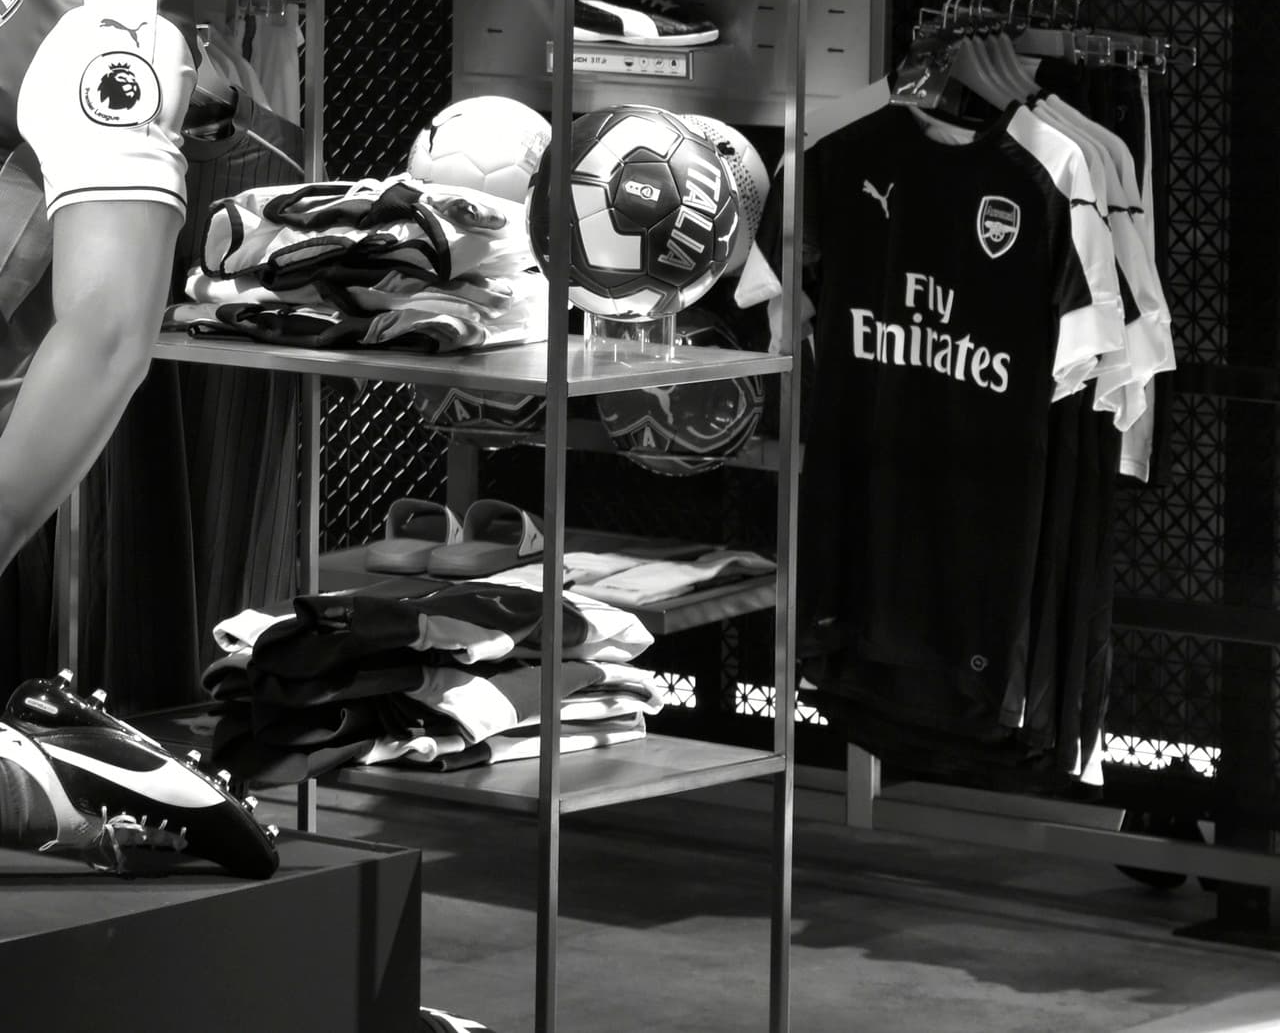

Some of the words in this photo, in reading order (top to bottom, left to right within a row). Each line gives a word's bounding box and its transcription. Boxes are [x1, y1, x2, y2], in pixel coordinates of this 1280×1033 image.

[657, 159, 722, 271] ITALIA
[905, 272, 955, 324] Fly
[849, 307, 1011, 394] Emirates
